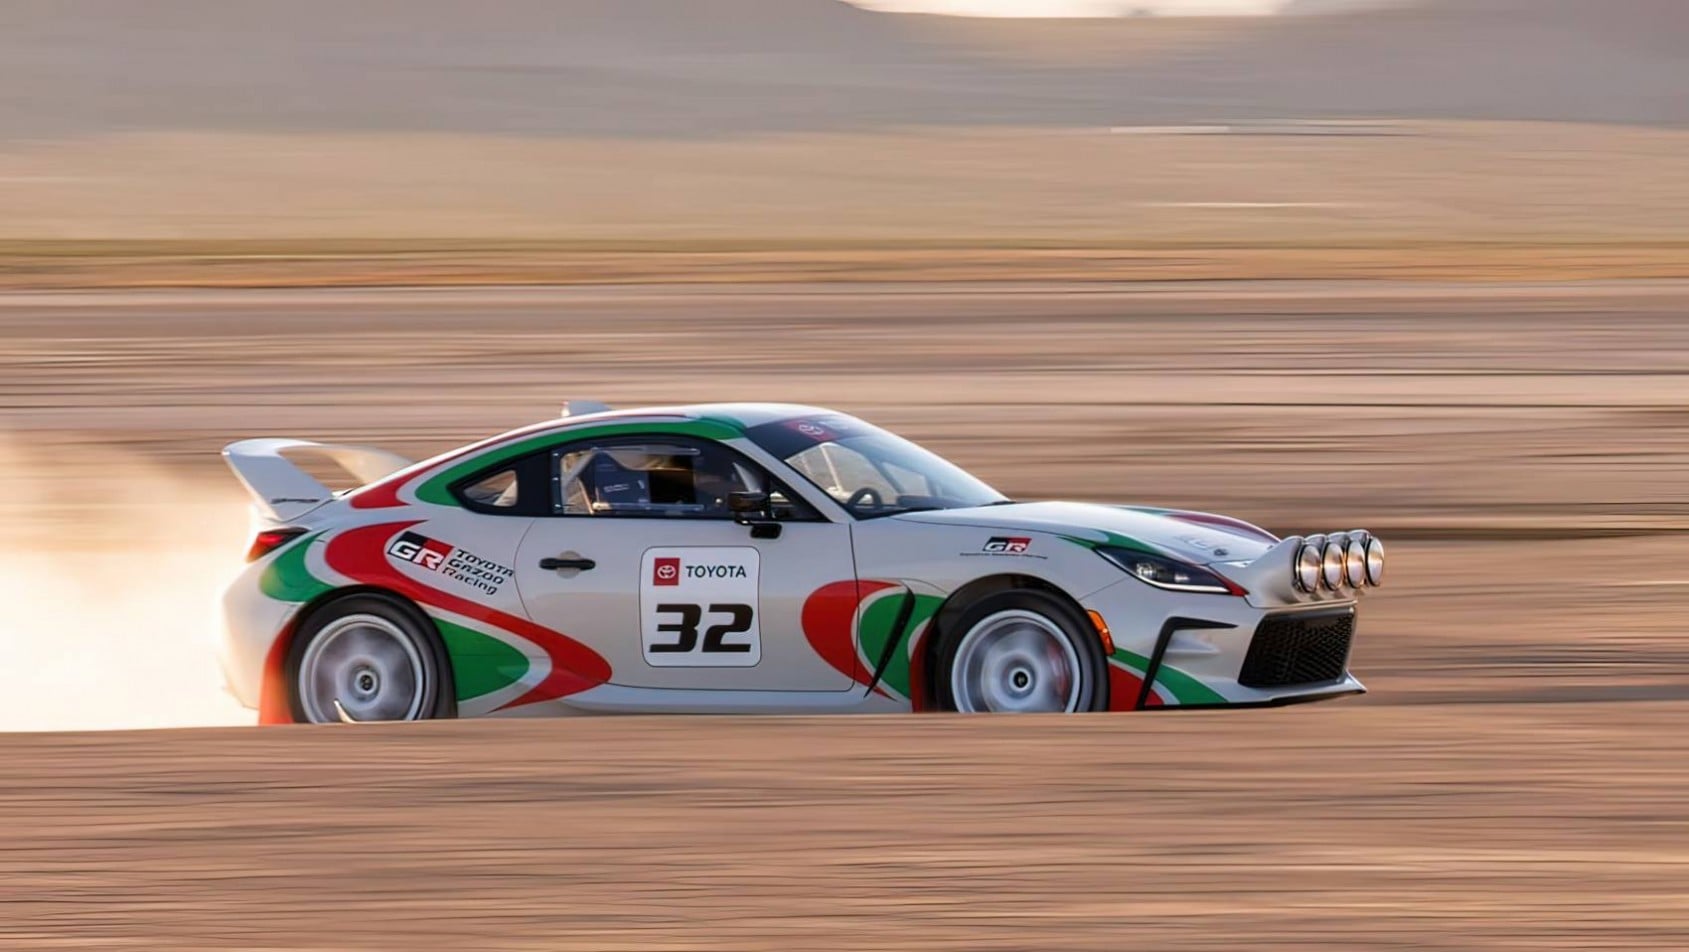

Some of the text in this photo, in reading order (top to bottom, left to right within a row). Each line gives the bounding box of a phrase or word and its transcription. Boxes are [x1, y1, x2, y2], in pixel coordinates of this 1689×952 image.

[390, 541, 445, 571] GR
[984, 542, 1029, 553] GR
[448, 558, 505, 585] GAZOO
[456, 549, 515, 577] TOYOTA
[686, 565, 747, 578] TOYOTA
[442, 567, 498, 596] Racing
[649, 603, 754, 653] 32
